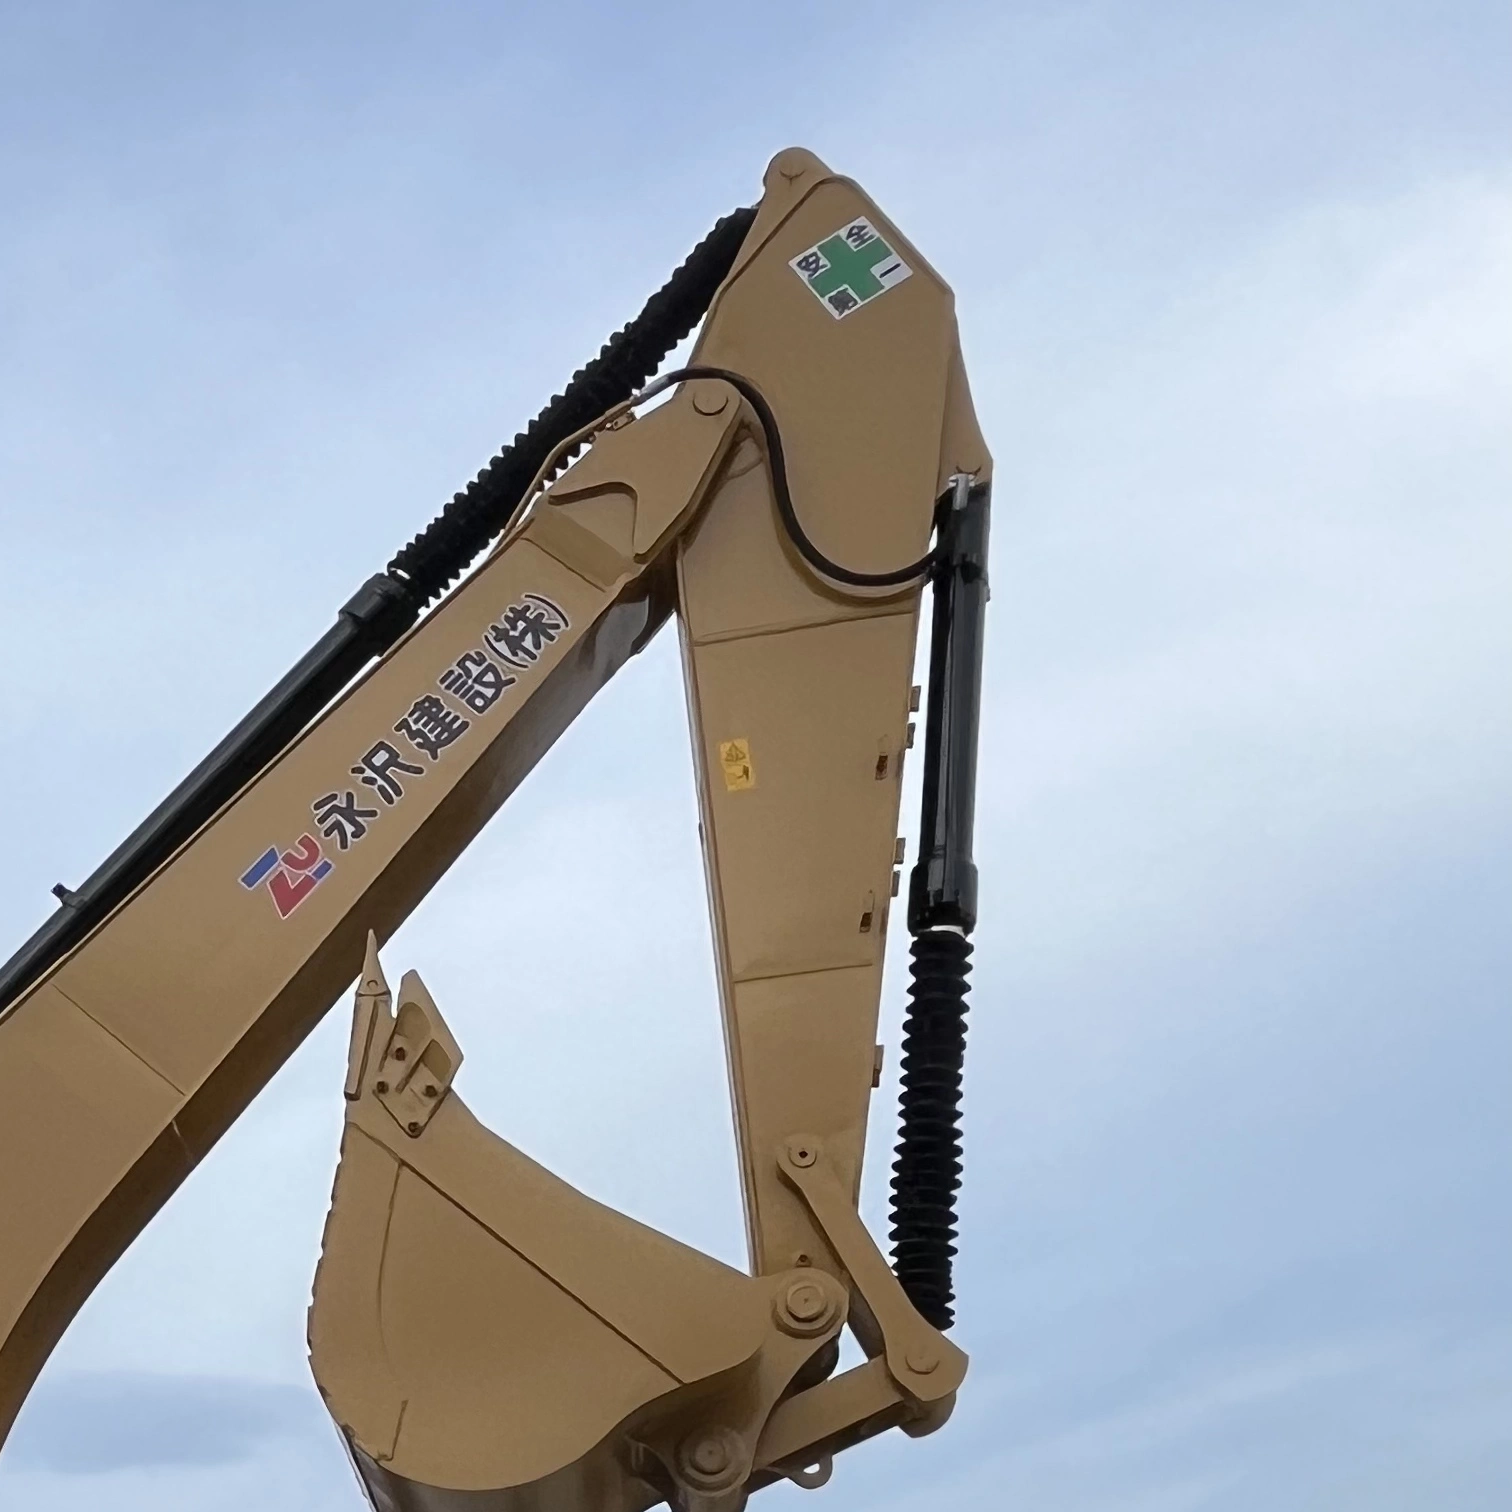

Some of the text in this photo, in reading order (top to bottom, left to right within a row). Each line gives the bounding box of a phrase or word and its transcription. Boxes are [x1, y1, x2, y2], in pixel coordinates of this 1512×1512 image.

[311, 593, 570, 852] 永沢建設(株)
